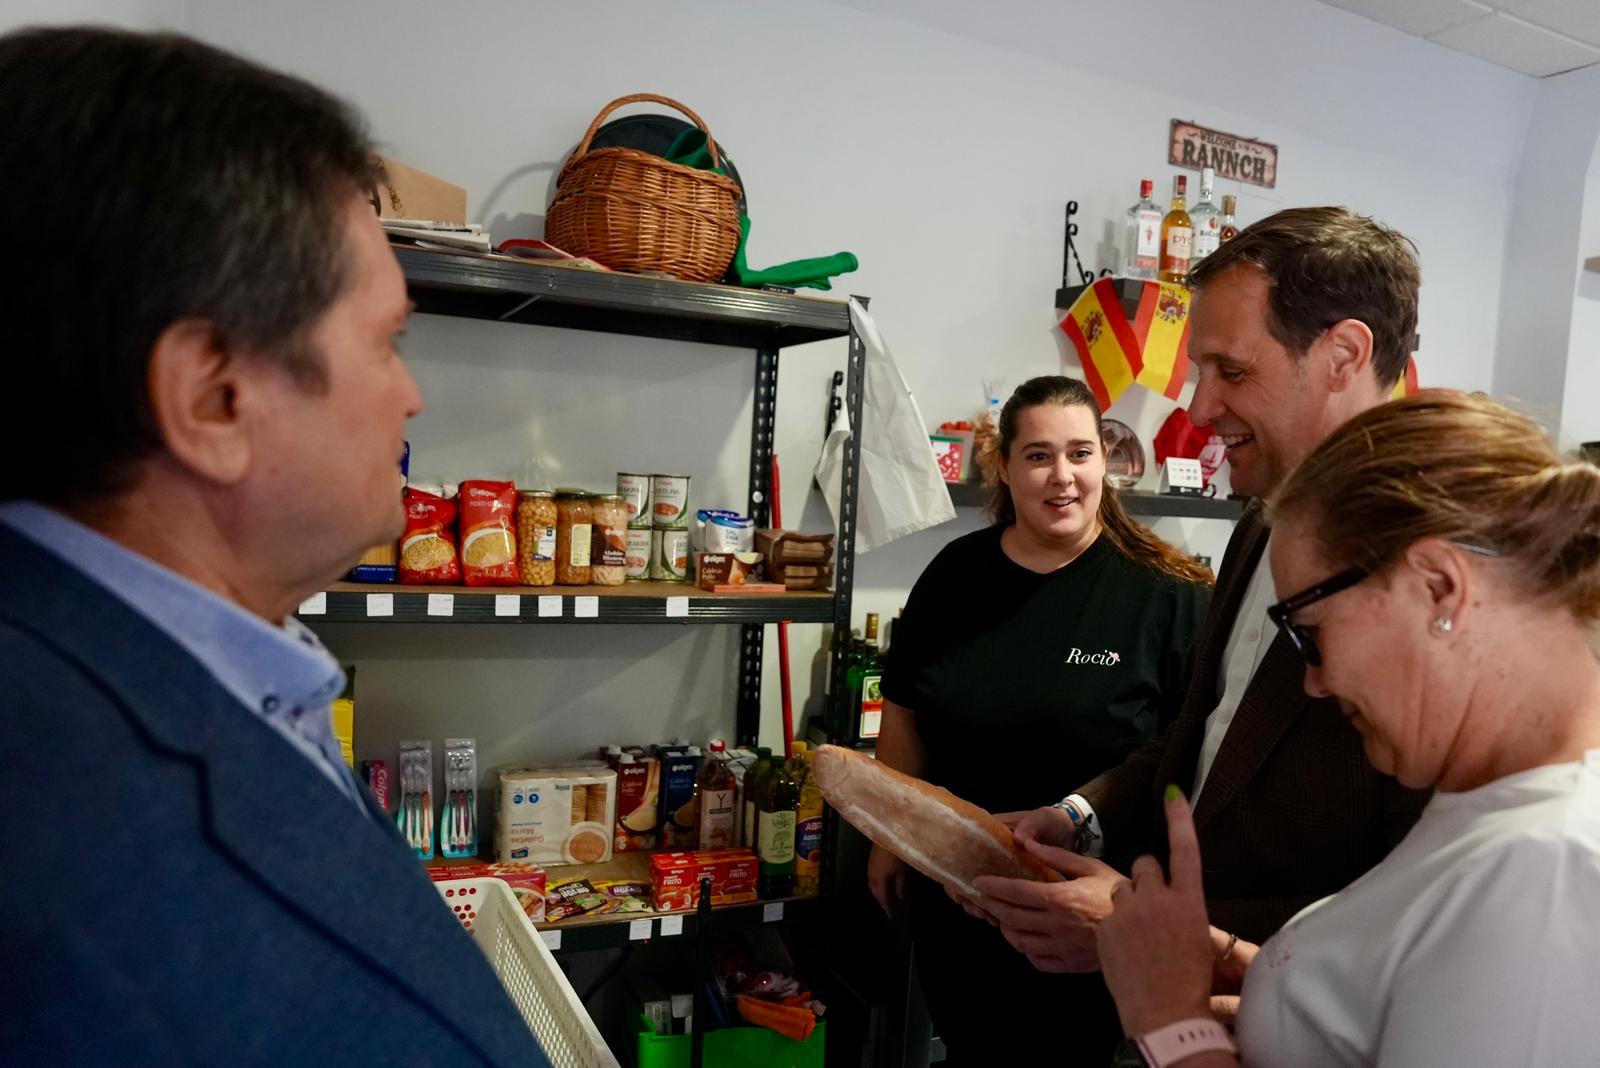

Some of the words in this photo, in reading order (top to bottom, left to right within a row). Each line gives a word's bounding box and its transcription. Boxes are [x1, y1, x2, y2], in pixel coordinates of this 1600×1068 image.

[1182, 138, 1266, 181] RANNCH
[375, 769, 388, 809] Colga
[804, 822, 823, 832] ABR
[511, 834, 545, 845] Galletas
[663, 878, 683, 886] FRITO
